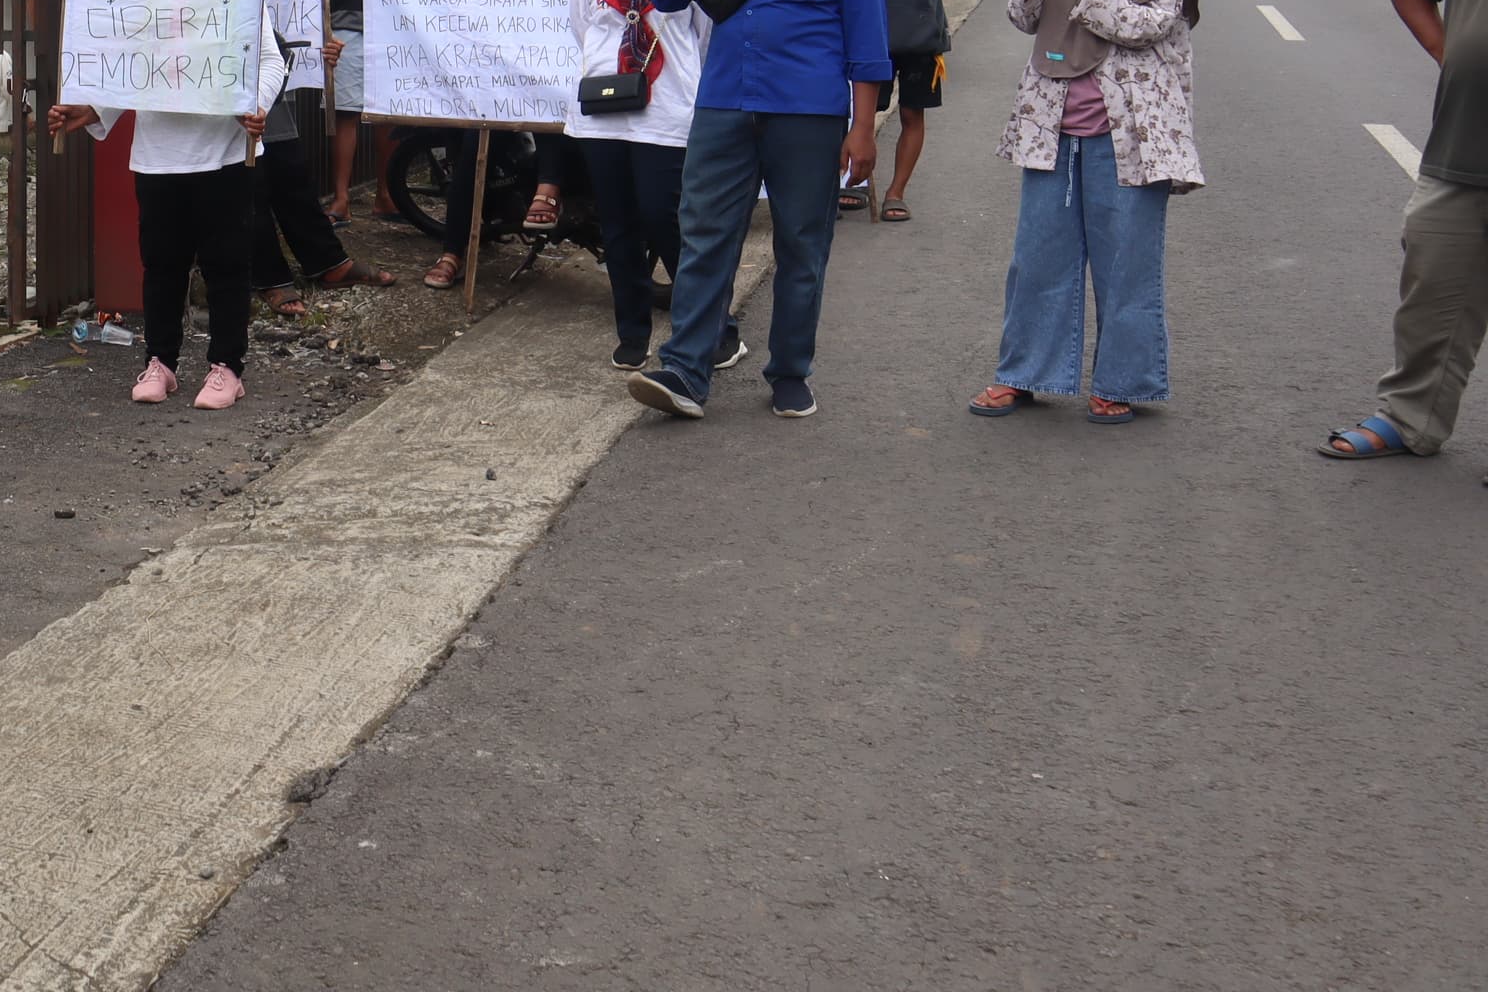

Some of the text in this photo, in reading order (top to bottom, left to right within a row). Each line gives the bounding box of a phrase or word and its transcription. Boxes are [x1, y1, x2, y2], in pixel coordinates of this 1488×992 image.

[392, 14, 572, 34] LAN KECEWA KARO RIKA
[61, 43, 251, 92] DEMOKRASI
[386, 42, 580, 72] RIKA KRASA APA OR
[395, 76, 430, 93] DESA
[434, 74, 482, 91] SIKAPAT
[491, 75, 517, 88] MAU
[518, 75, 561, 88] DIBAWA
[493, 97, 569, 120] MUNDUR
